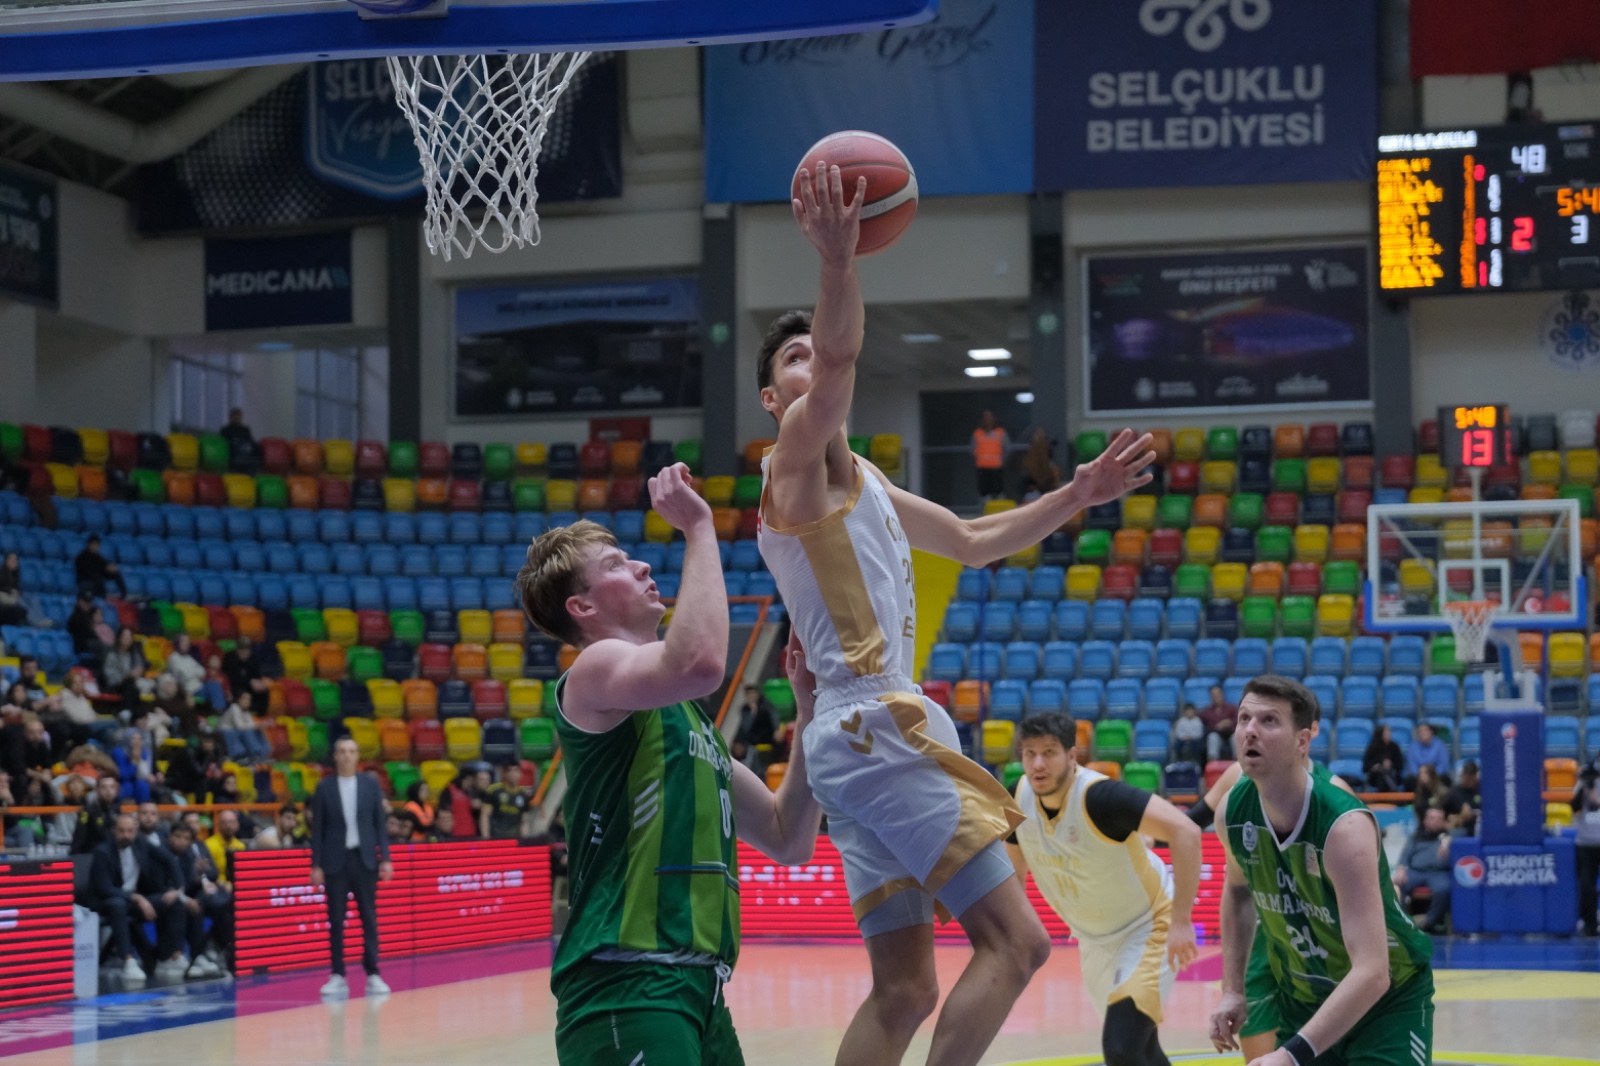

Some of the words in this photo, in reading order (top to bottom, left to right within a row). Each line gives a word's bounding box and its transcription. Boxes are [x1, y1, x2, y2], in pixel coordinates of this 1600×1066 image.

[1088, 64, 1325, 115] SELÇUKLU
[1085, 103, 1325, 152] BELEDİYESİ
[1511, 144, 1546, 173] 48
[1557, 187, 1600, 216] 5:4
[1512, 217, 1534, 251] 2
[1570, 215, 1589, 244] 3
[207, 266, 334, 297] MEDICANA
[1463, 430, 1493, 466] 13
